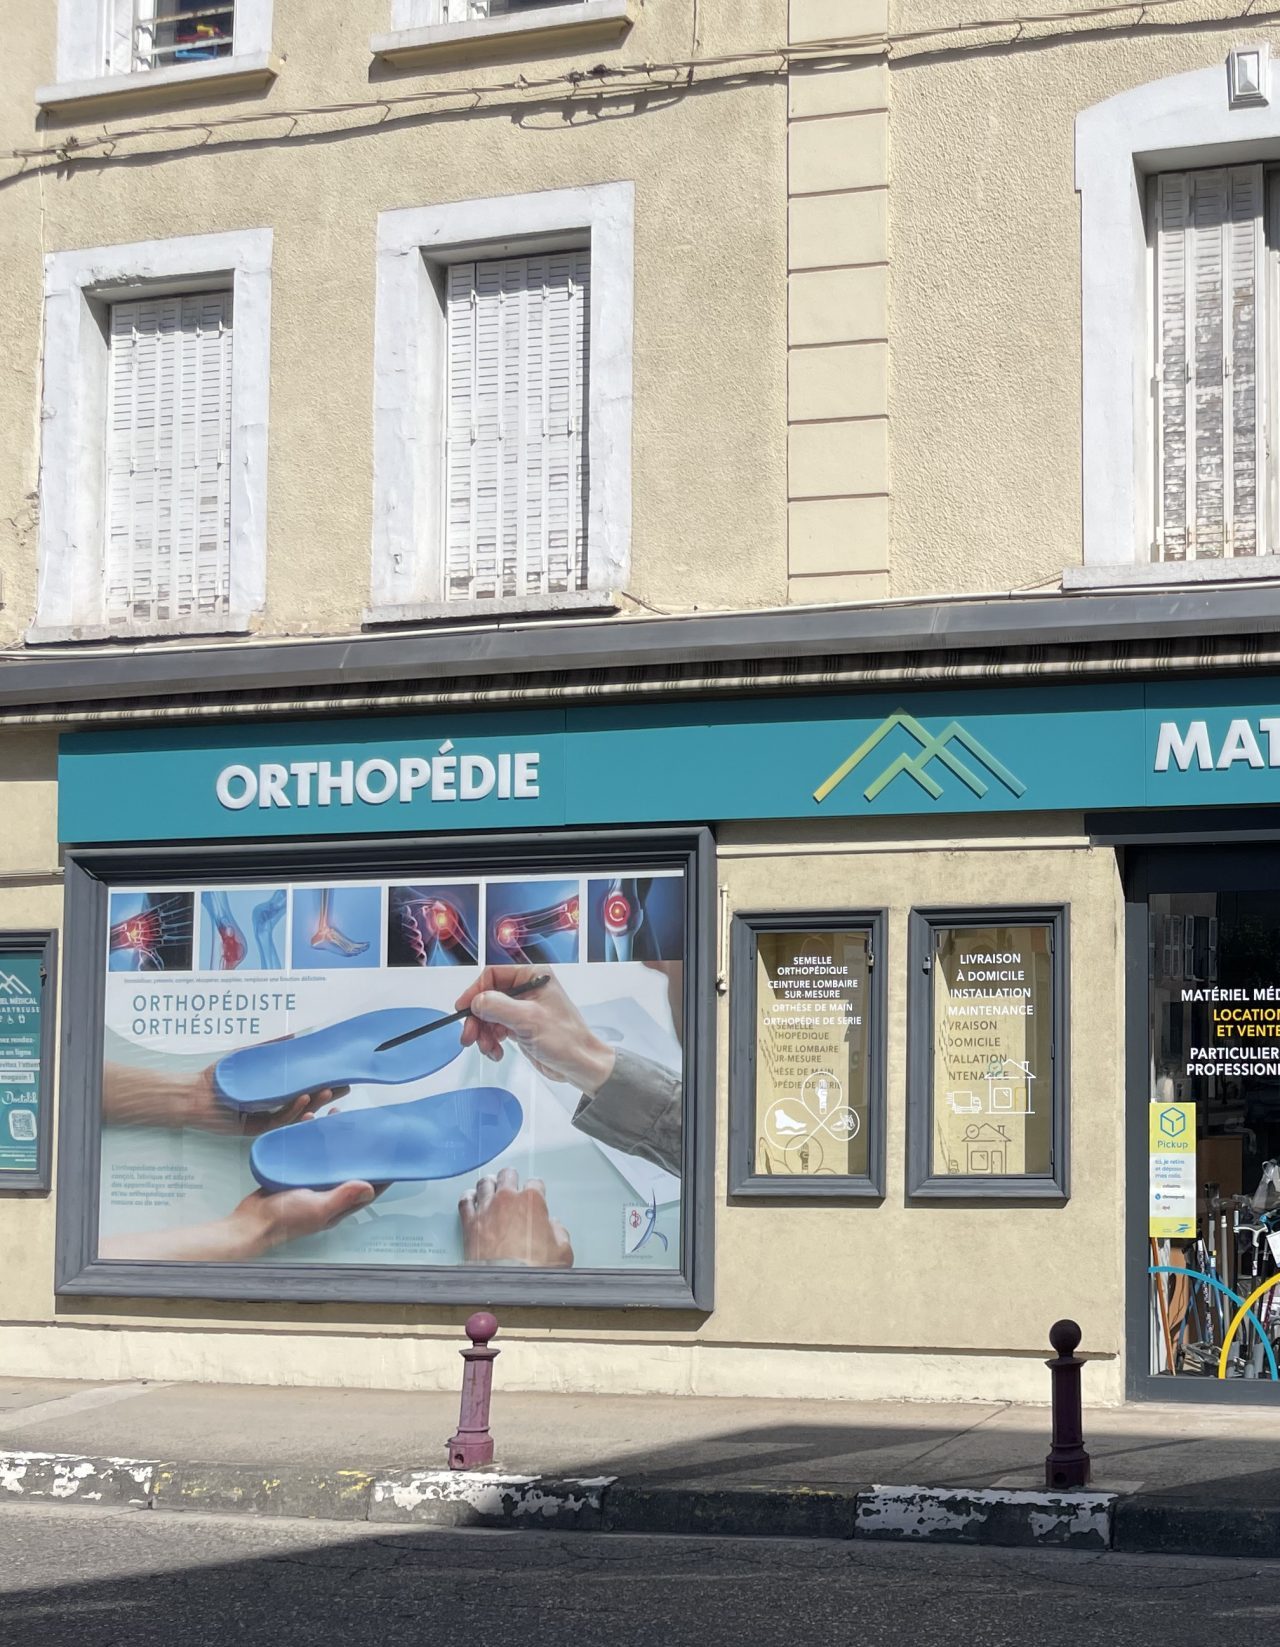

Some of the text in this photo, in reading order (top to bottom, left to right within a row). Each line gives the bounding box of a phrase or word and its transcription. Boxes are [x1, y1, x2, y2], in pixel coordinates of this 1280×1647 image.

[216, 739, 540, 810] ORTHOPÉDIE
[794, 956, 832, 965] SEMELLE
[960, 954, 1021, 965] LIVRAISON
[777, 966, 848, 975] ORTHOPÉDIQUE
[956, 969, 1025, 982] À DOMICILE
[768, 980, 858, 988] CEINTURE LOMBAIRE
[784, 990, 840, 998] SUR-MESURE
[950, 988, 1031, 999] INSTALLATION
[1181, 986, 1250, 1002] MATÉRIEL
[132, 990, 296, 1012] ORTHOPÉDISTE
[772, 1004, 812, 1012] ORTHÈSE
[814, 1004, 826, 1012] DE
[948, 1005, 1034, 1016] MAINTENANCE
[132, 1014, 260, 1035] ORTHÉSISTE
[764, 1016, 820, 1025] ORTHOPÉDIE
[823, 1016, 834, 1024] DE
[1217, 1024, 1234, 1037] ET
[1157, 1140, 1188, 1149] Pickup
